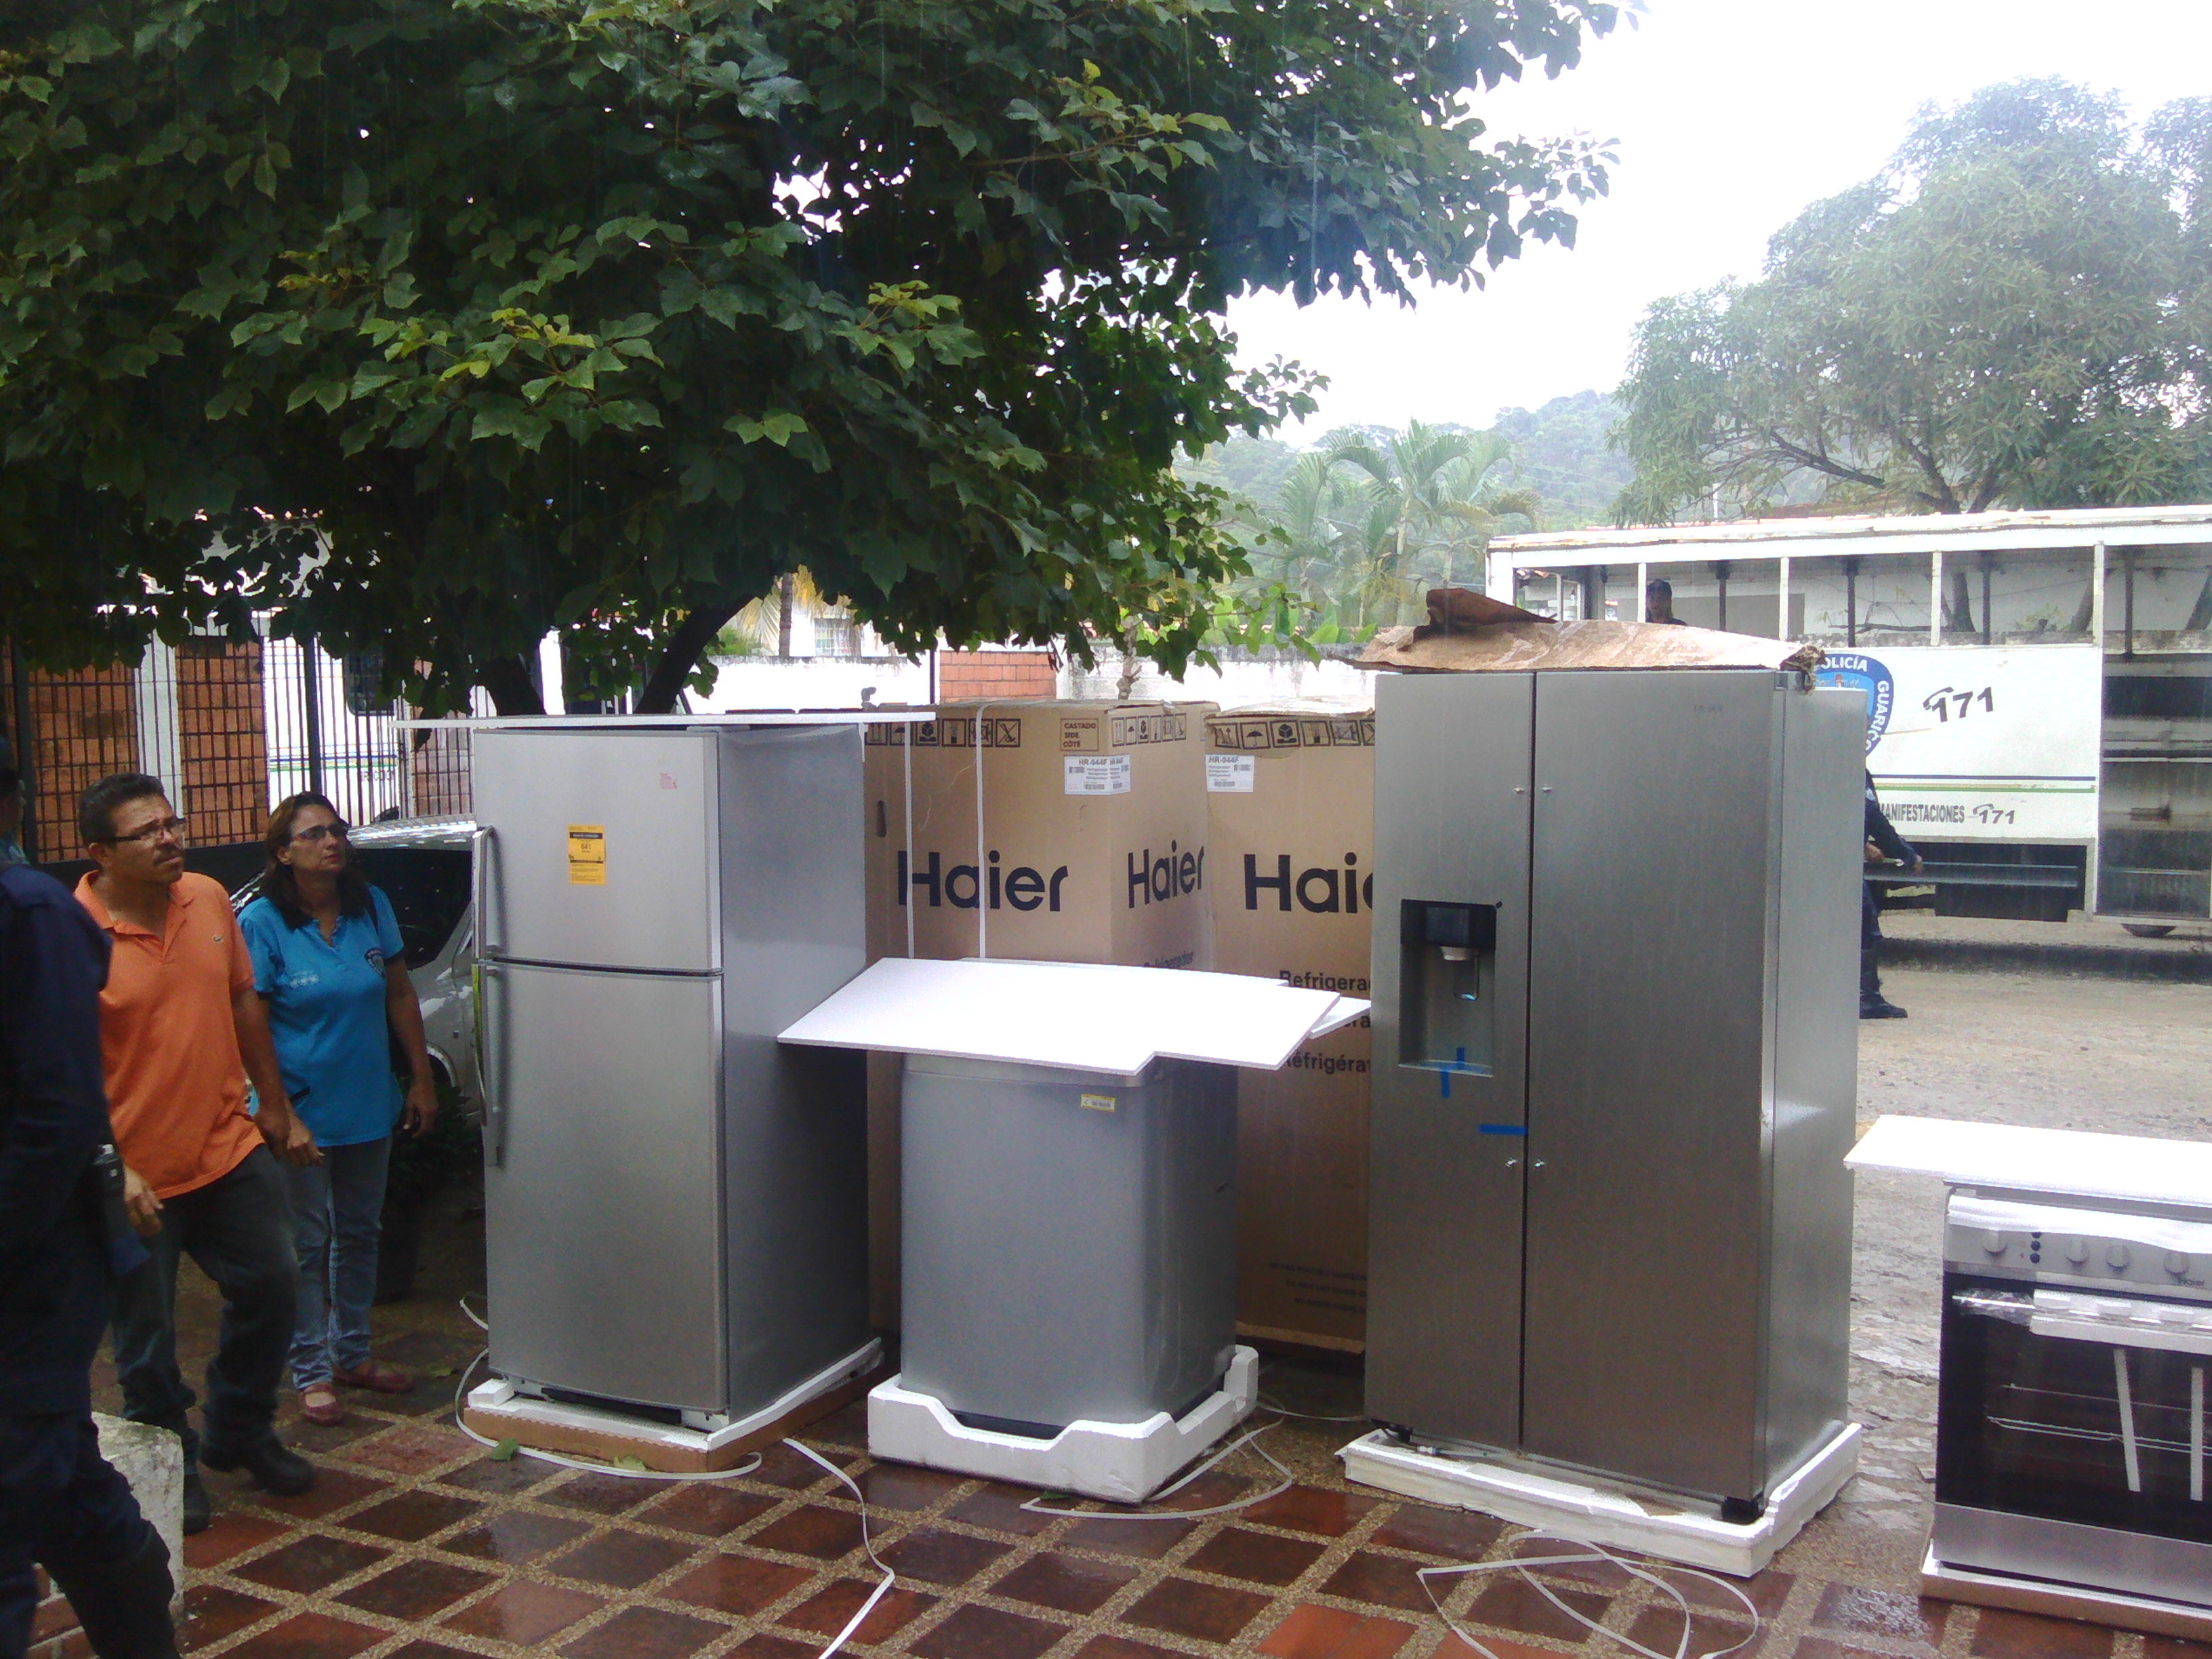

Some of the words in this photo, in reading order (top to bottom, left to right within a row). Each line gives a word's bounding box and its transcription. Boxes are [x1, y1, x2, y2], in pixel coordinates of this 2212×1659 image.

[1814, 656, 1867, 672] OLICÍA
[1932, 687, 1994, 722] 171
[1979, 809, 2015, 824] 171
[897, 850, 1068, 912] Haier
[1128, 840, 1205, 909] Haier
[1244, 852, 1373, 914] Hai
[1279, 970, 1371, 992] Refrigera
